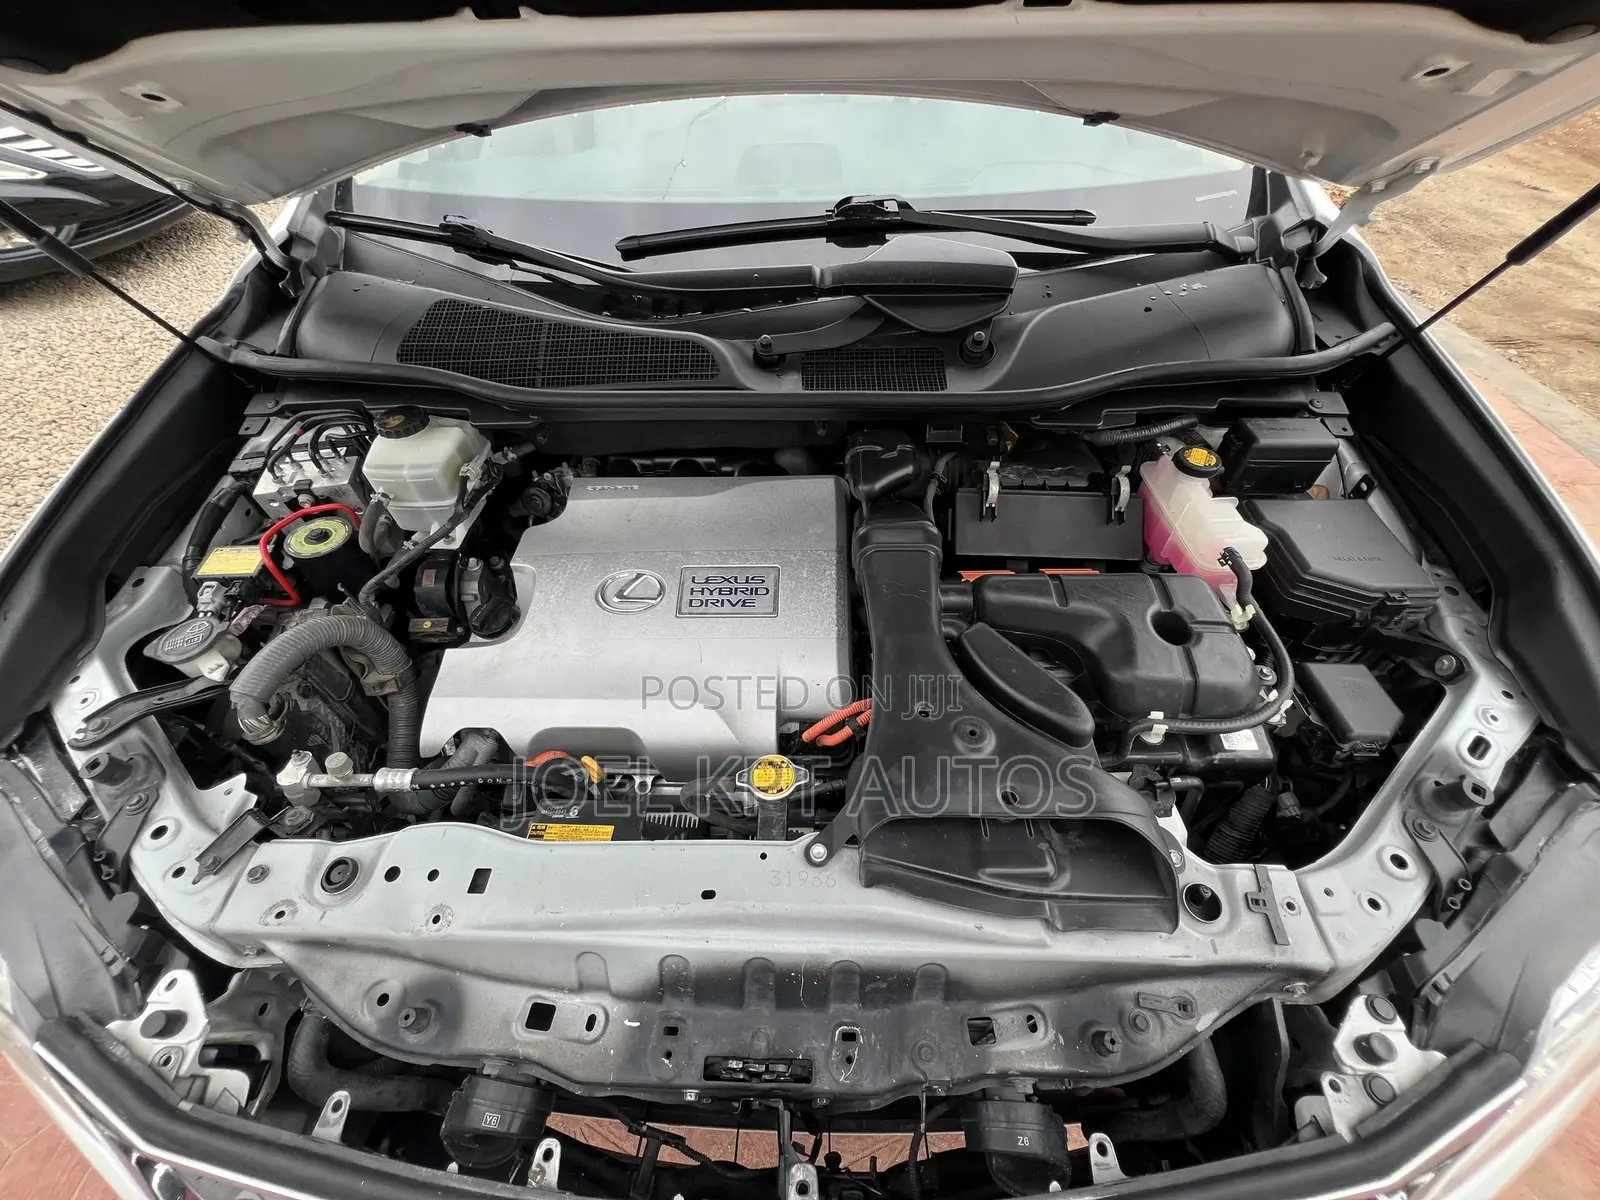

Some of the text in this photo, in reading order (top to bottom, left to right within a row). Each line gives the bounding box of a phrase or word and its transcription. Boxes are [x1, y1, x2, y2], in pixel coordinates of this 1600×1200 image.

[691, 575, 766, 584] LEXUS
[690, 587, 770, 595] HYBRID
[688, 598, 757, 608] DRIVE
[770, 869, 837, 888] 31936
[486, 1115, 498, 1126] Y6
[1017, 1136, 1030, 1146] Z6
